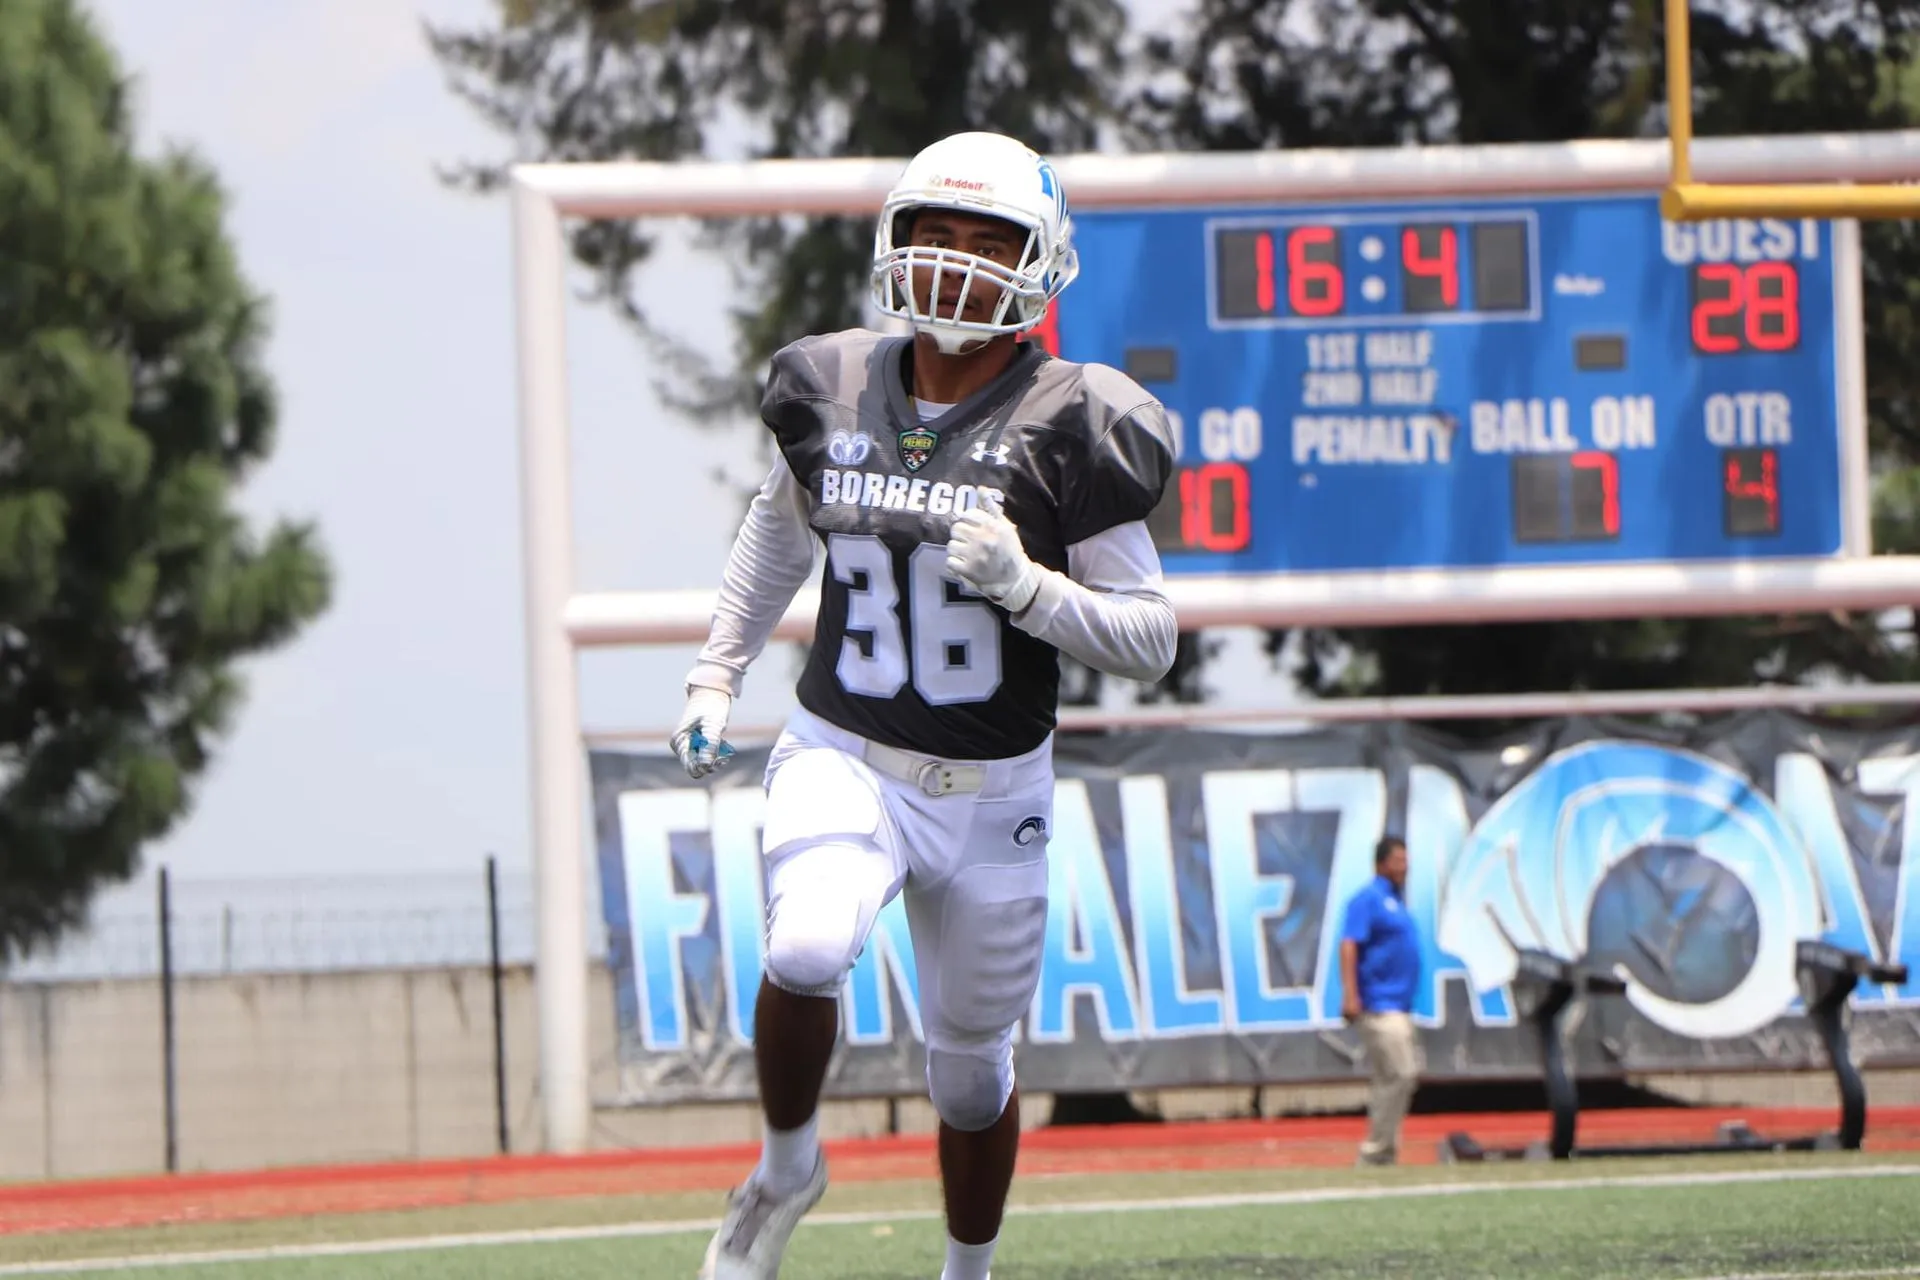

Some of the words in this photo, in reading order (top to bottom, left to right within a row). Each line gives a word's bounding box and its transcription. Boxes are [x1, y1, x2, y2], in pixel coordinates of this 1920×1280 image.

[1692, 261, 1799, 352] 28
[902, 437, 933, 449] PREMIER
[1200, 409, 1261, 461] GO
[1292, 414, 1456, 464] PENALTY
[1471, 400, 1577, 454] BALL
[1591, 395, 1656, 449] ON
[1705, 393, 1792, 445] QTR
[1180, 463, 1249, 552] 10
[1570, 452, 1620, 535] 7
[1726, 450, 1777, 530] 4
[828, 533, 1003, 706] 36
[618, 765, 1517, 1051] FALEZA
